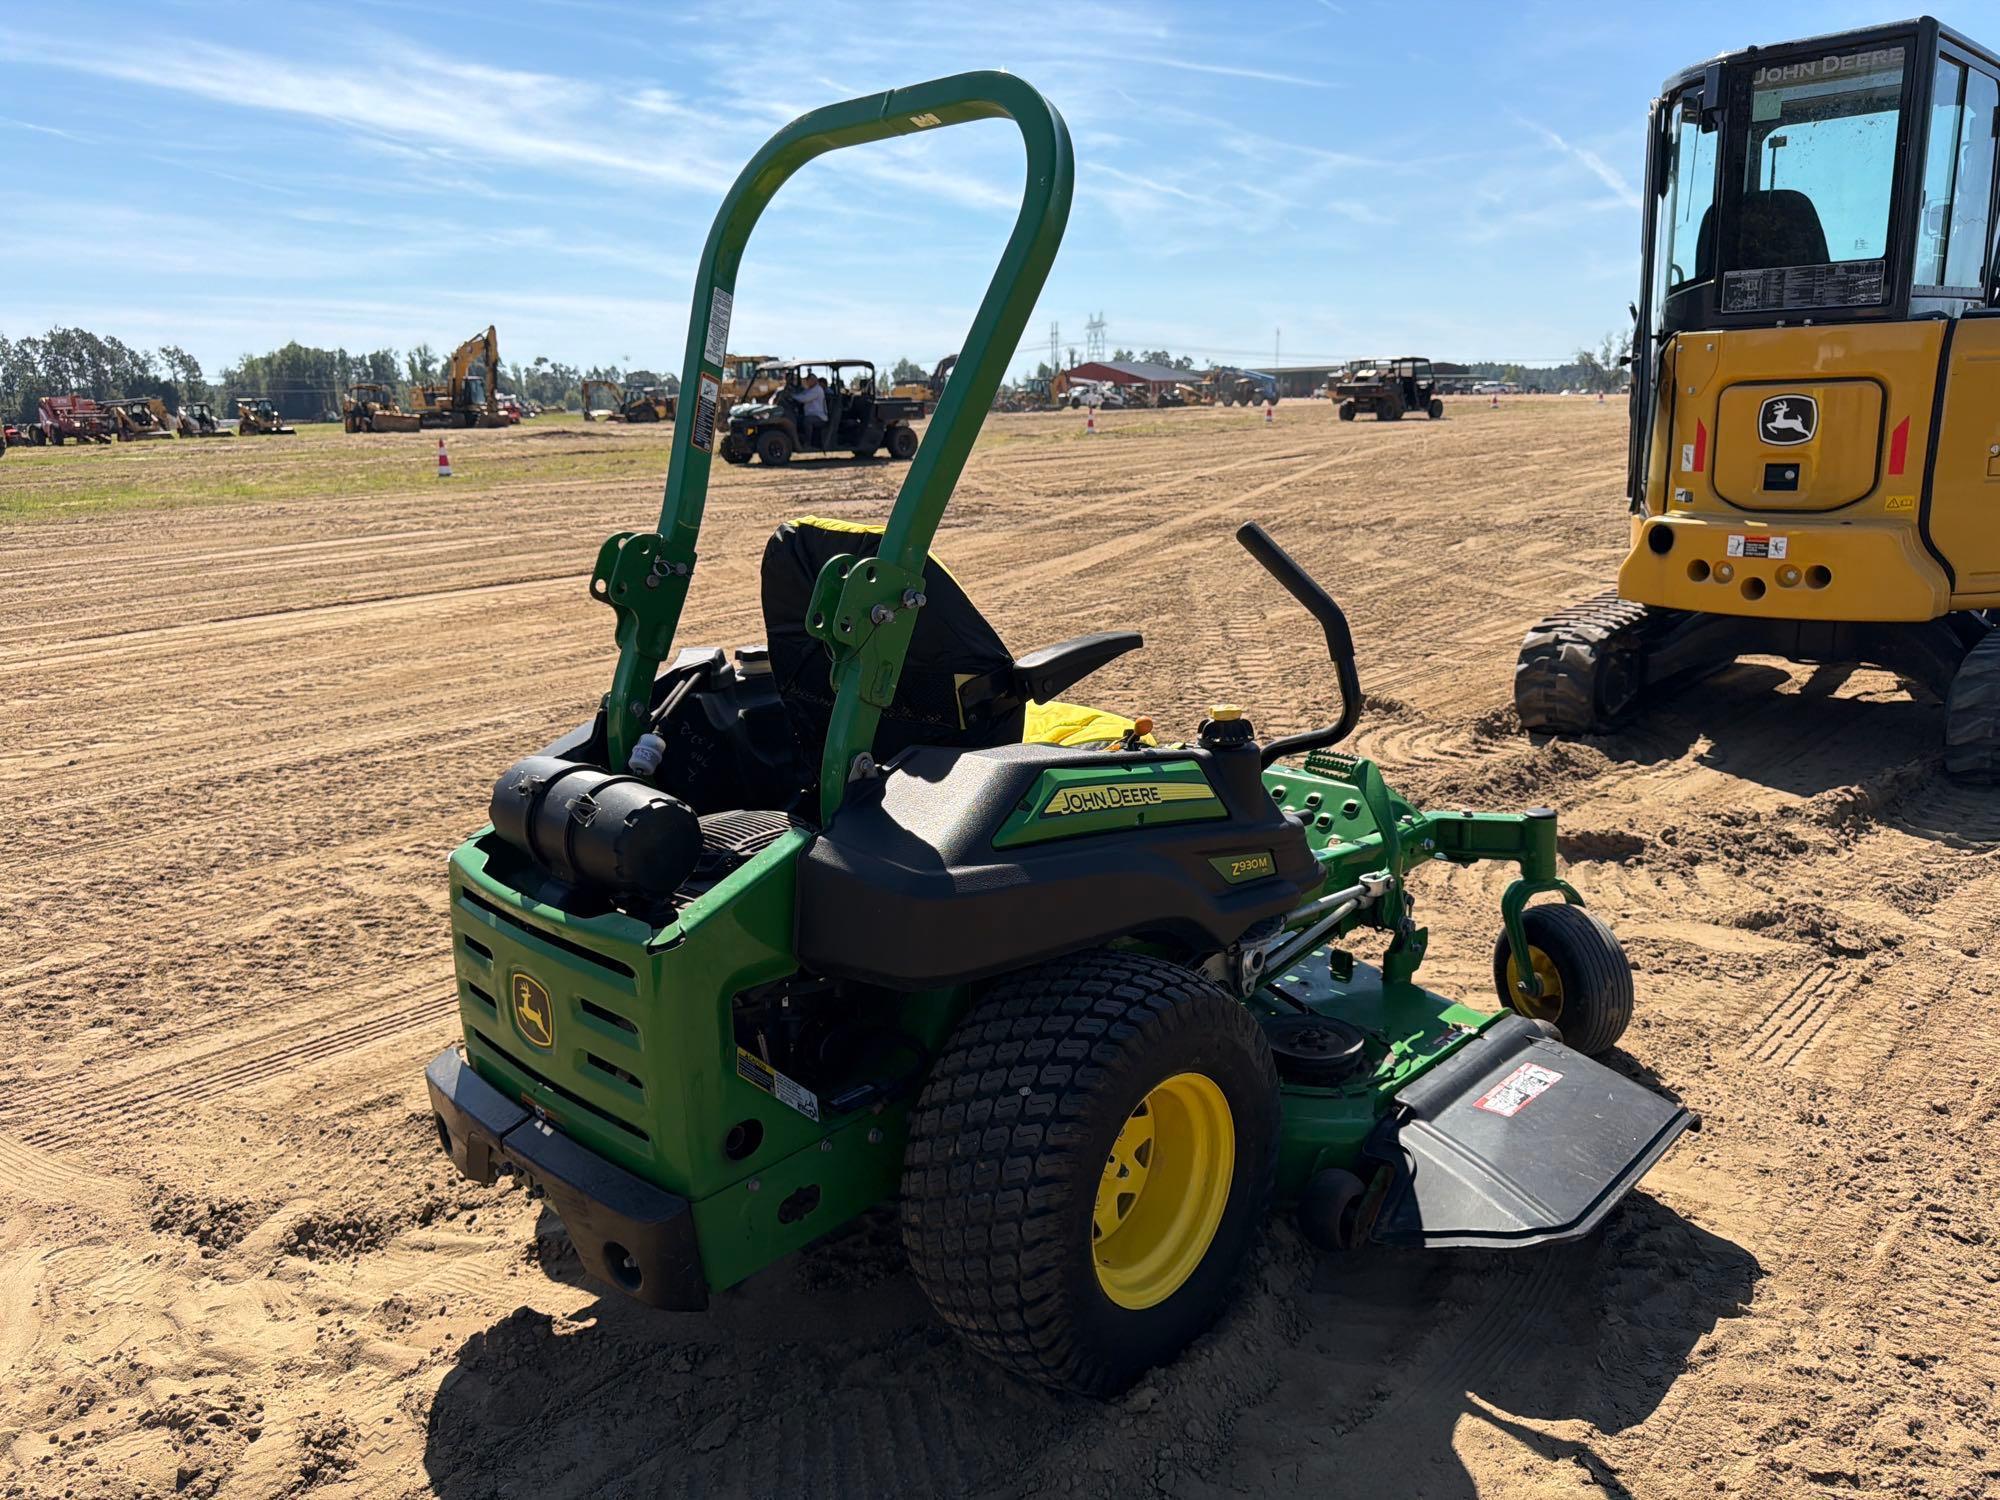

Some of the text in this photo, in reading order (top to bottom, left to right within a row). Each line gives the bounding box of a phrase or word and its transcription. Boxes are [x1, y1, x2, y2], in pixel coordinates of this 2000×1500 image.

[1753, 46, 1906, 85] JOHN DEERE
[1061, 786, 1162, 812] JOHN DEERE
[1231, 856, 1268, 877] Z930M
